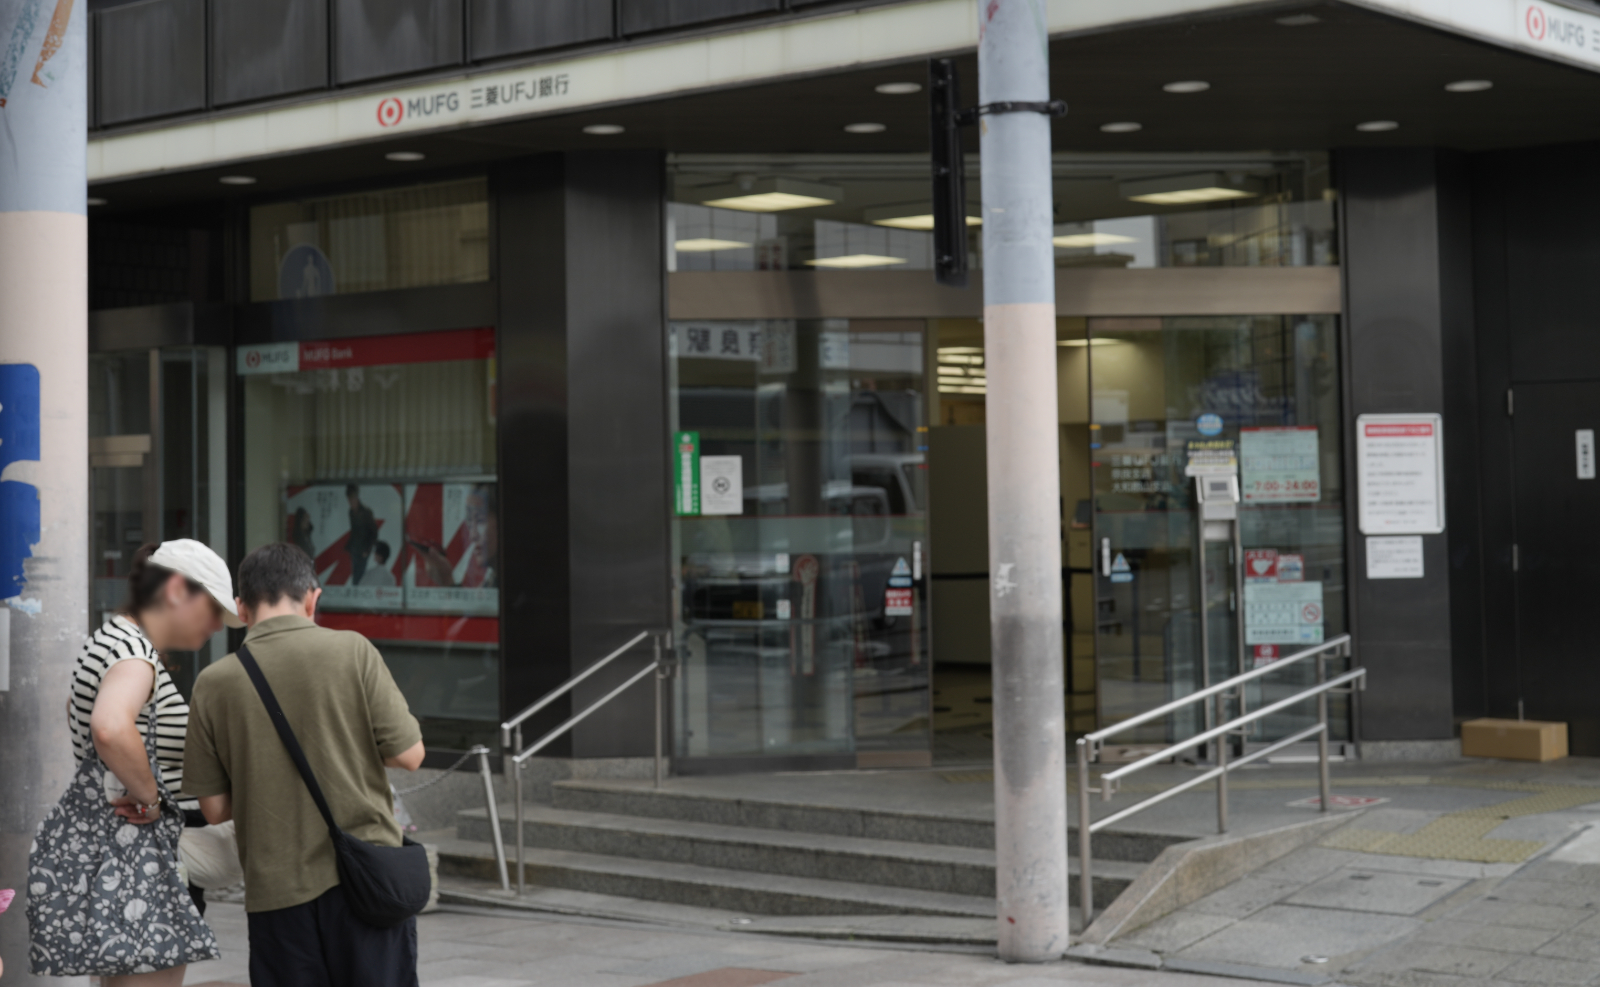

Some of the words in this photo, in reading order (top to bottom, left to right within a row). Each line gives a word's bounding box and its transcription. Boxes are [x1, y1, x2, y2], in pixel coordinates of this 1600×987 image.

[1548, 17, 1585, 47] MUFG
[407, 92, 459, 118] MUFG
[470, 73, 570, 109] 三菱UFJ銀行
